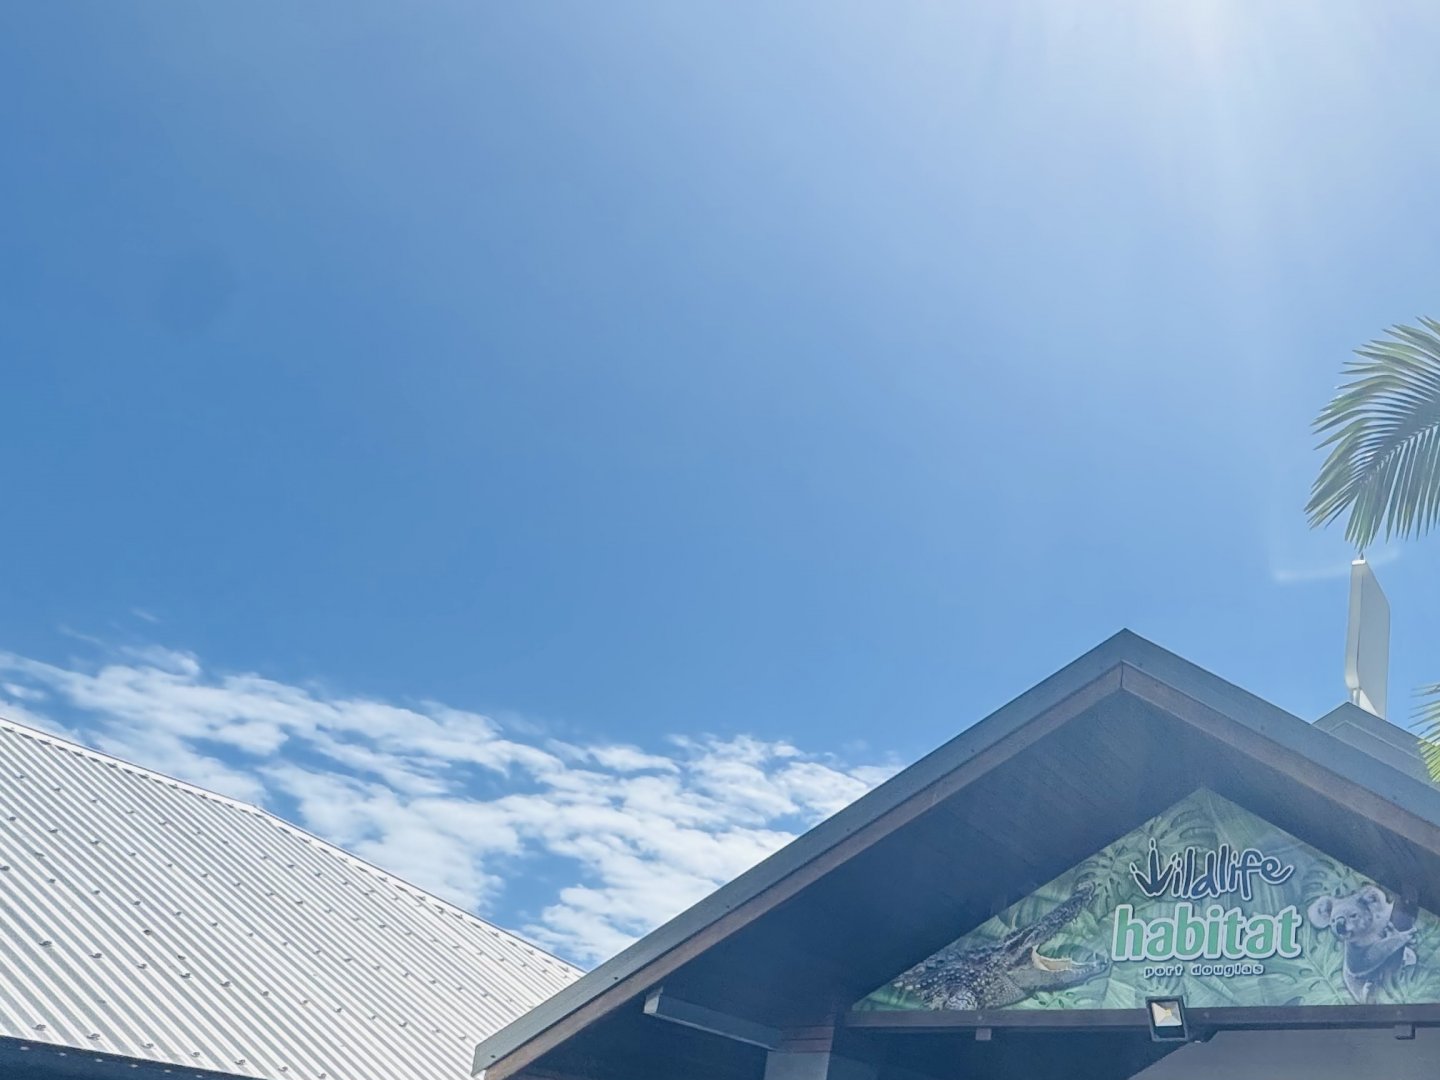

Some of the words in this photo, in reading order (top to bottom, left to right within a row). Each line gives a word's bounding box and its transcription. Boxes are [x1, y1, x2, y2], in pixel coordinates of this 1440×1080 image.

[1112, 902, 1302, 961] habitat
[1144, 963, 1184, 978] port
[1191, 962, 1264, 977] douglas
